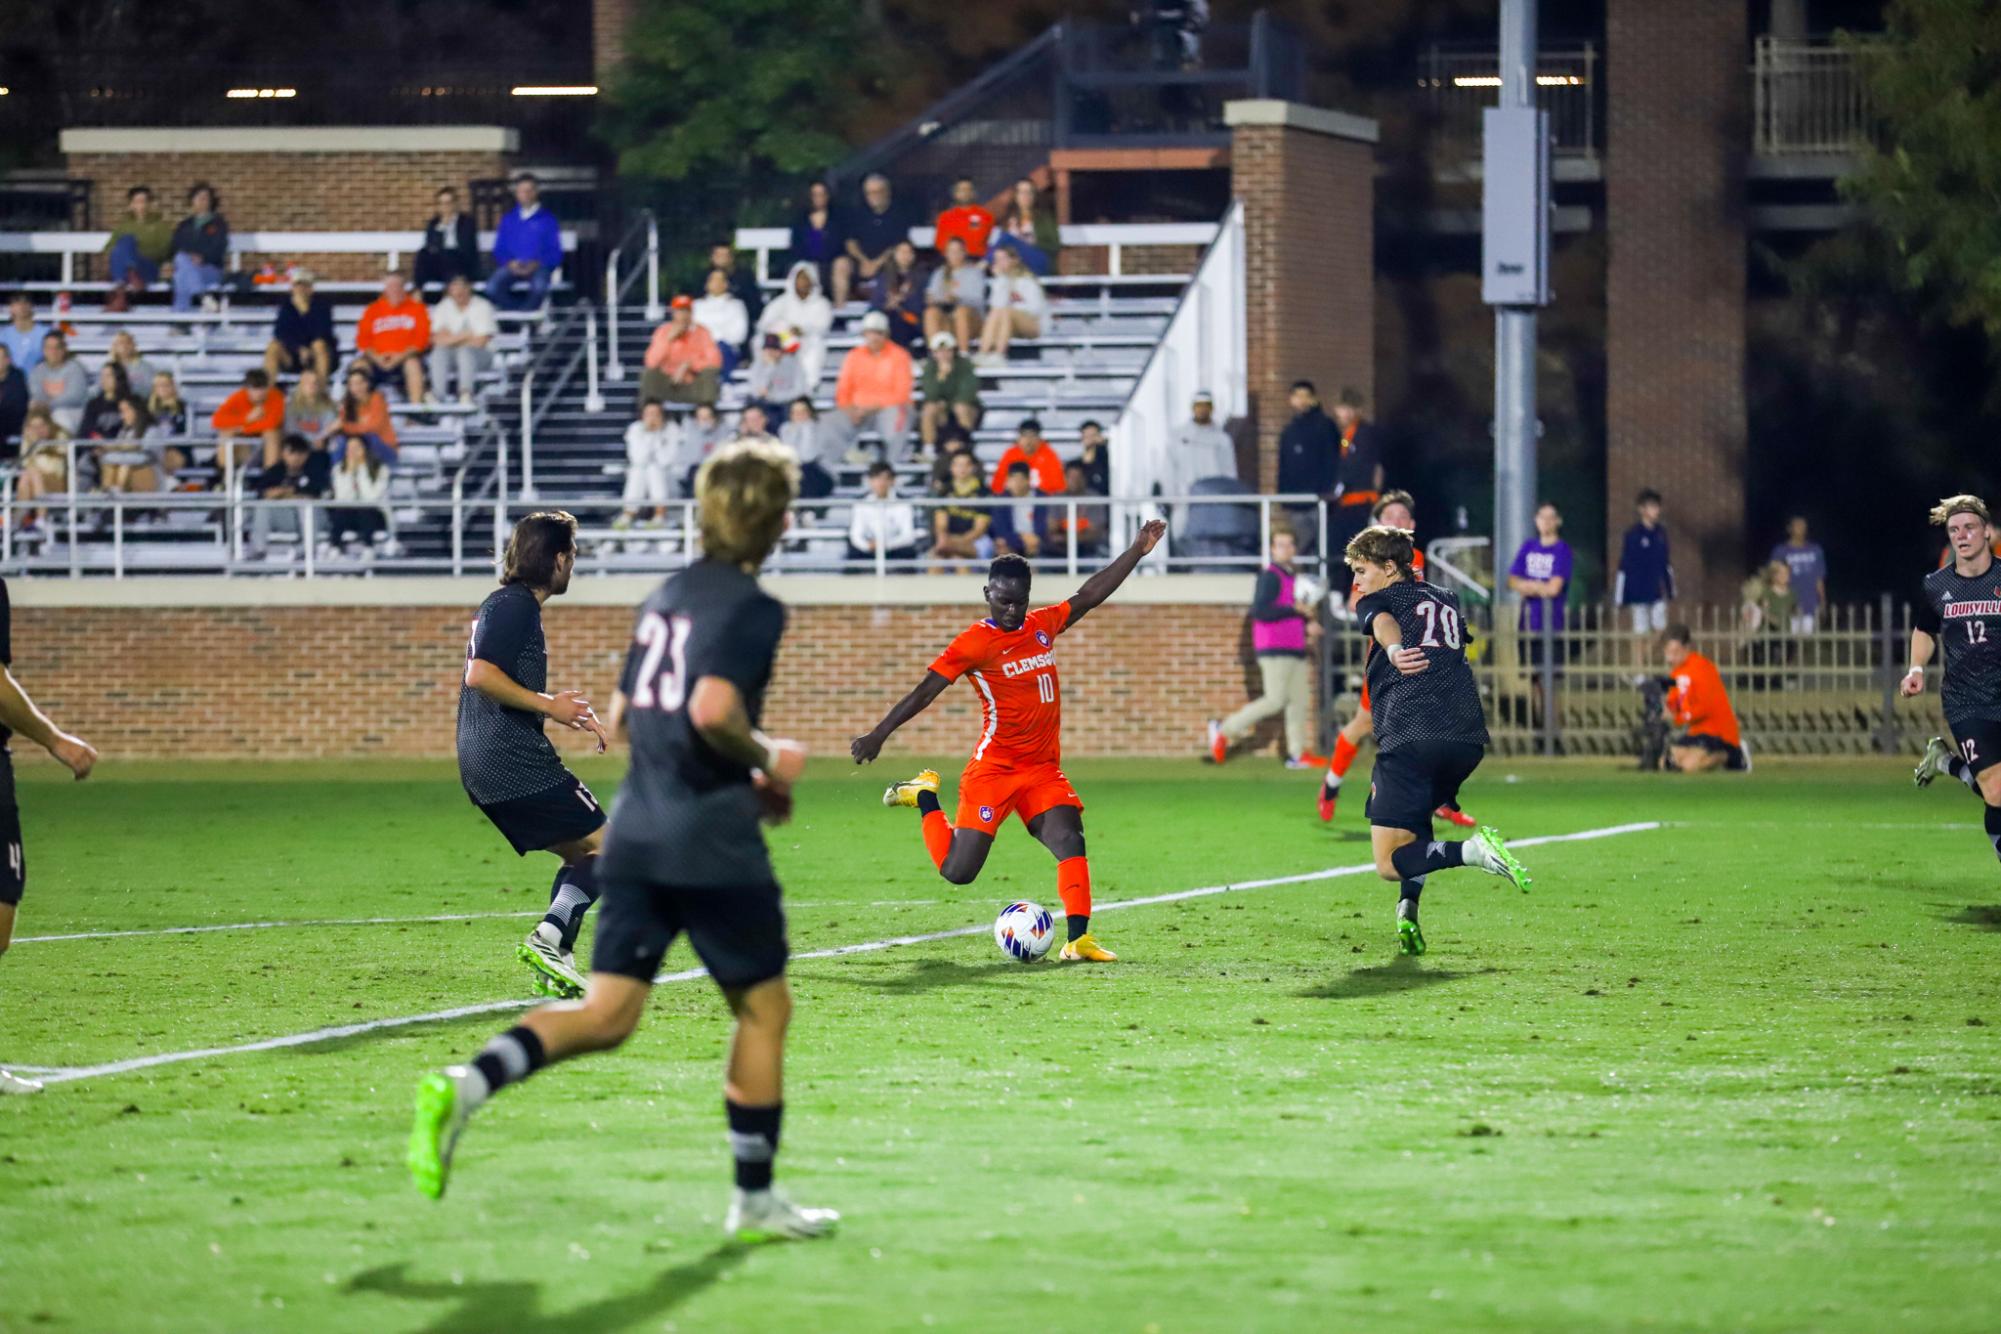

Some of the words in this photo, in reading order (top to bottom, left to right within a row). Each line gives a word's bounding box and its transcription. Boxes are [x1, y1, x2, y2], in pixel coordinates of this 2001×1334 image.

[1416, 600, 1460, 650] 20
[1966, 620, 1988, 644] 12
[632, 611, 692, 712] 23
[1037, 673, 1055, 703] 10
[1960, 738, 1979, 765] 12
